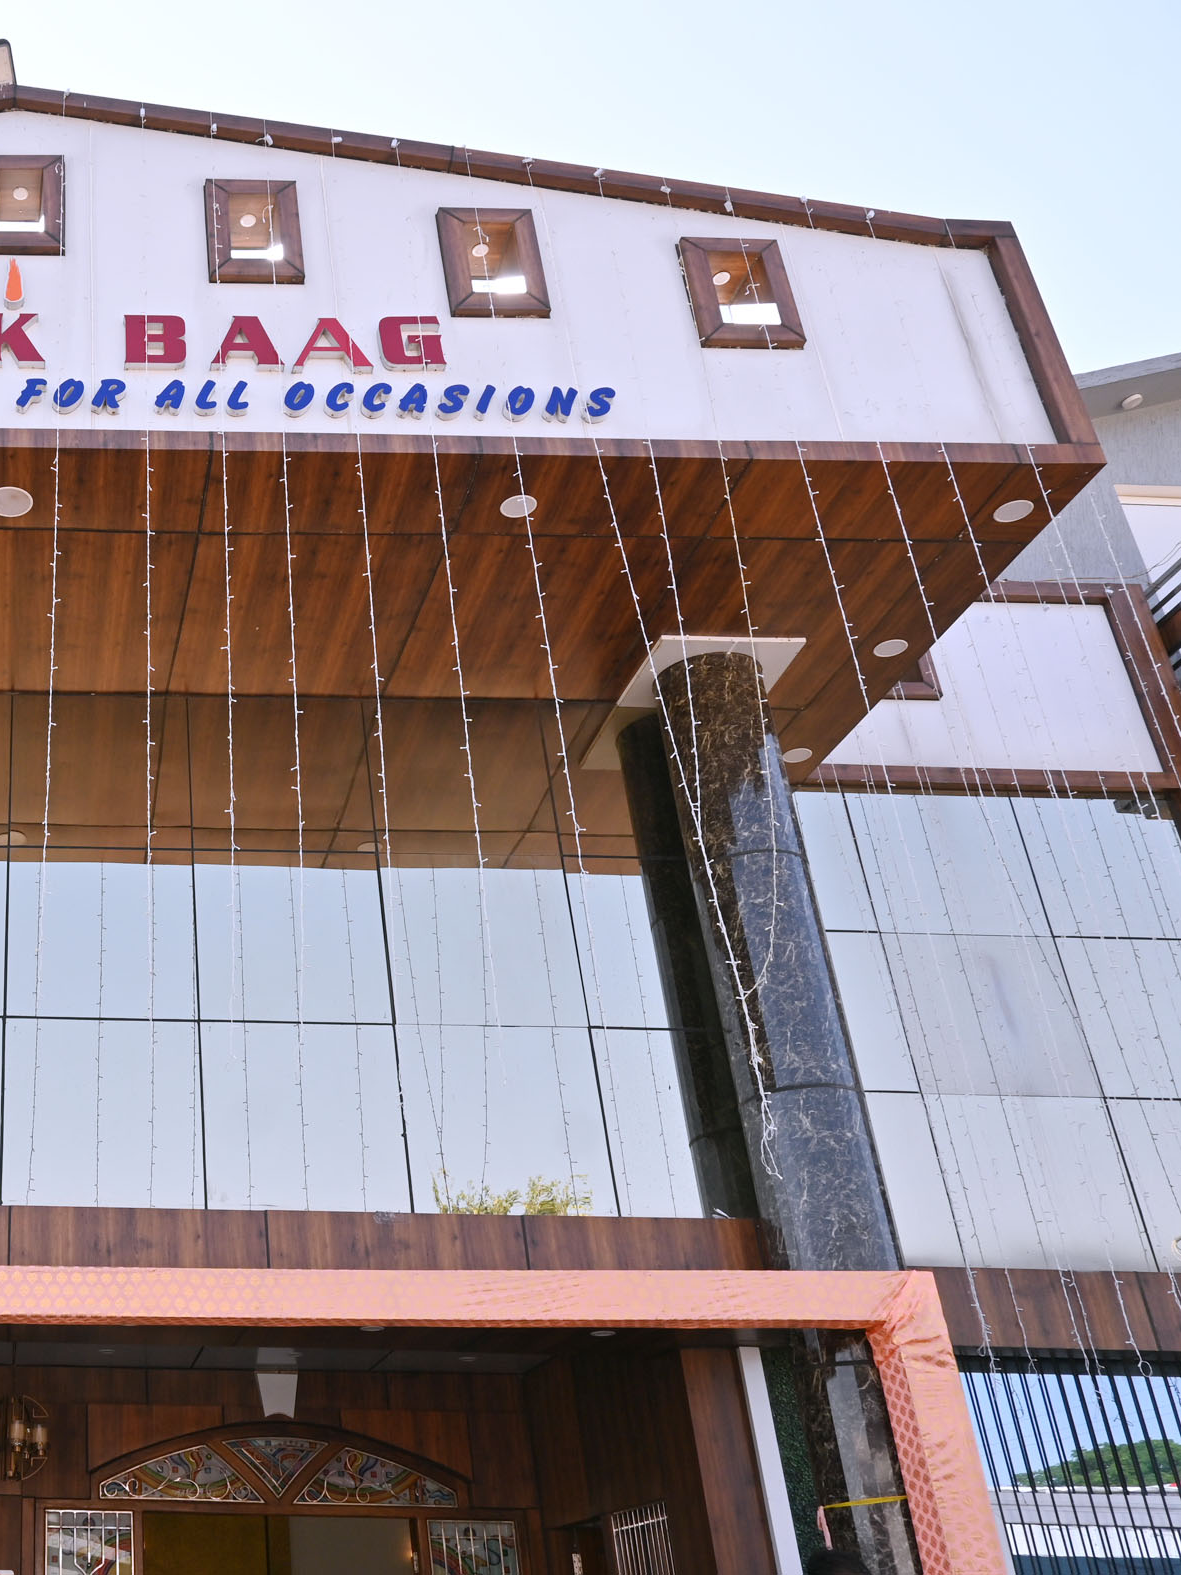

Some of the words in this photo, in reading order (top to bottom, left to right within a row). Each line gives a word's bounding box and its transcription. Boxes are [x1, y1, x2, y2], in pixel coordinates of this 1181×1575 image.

[122, 315, 447, 371] BAAG
[16, 378, 127, 414] FOR
[154, 379, 249, 416] ALL
[283, 381, 616, 423] OCCASIONS
